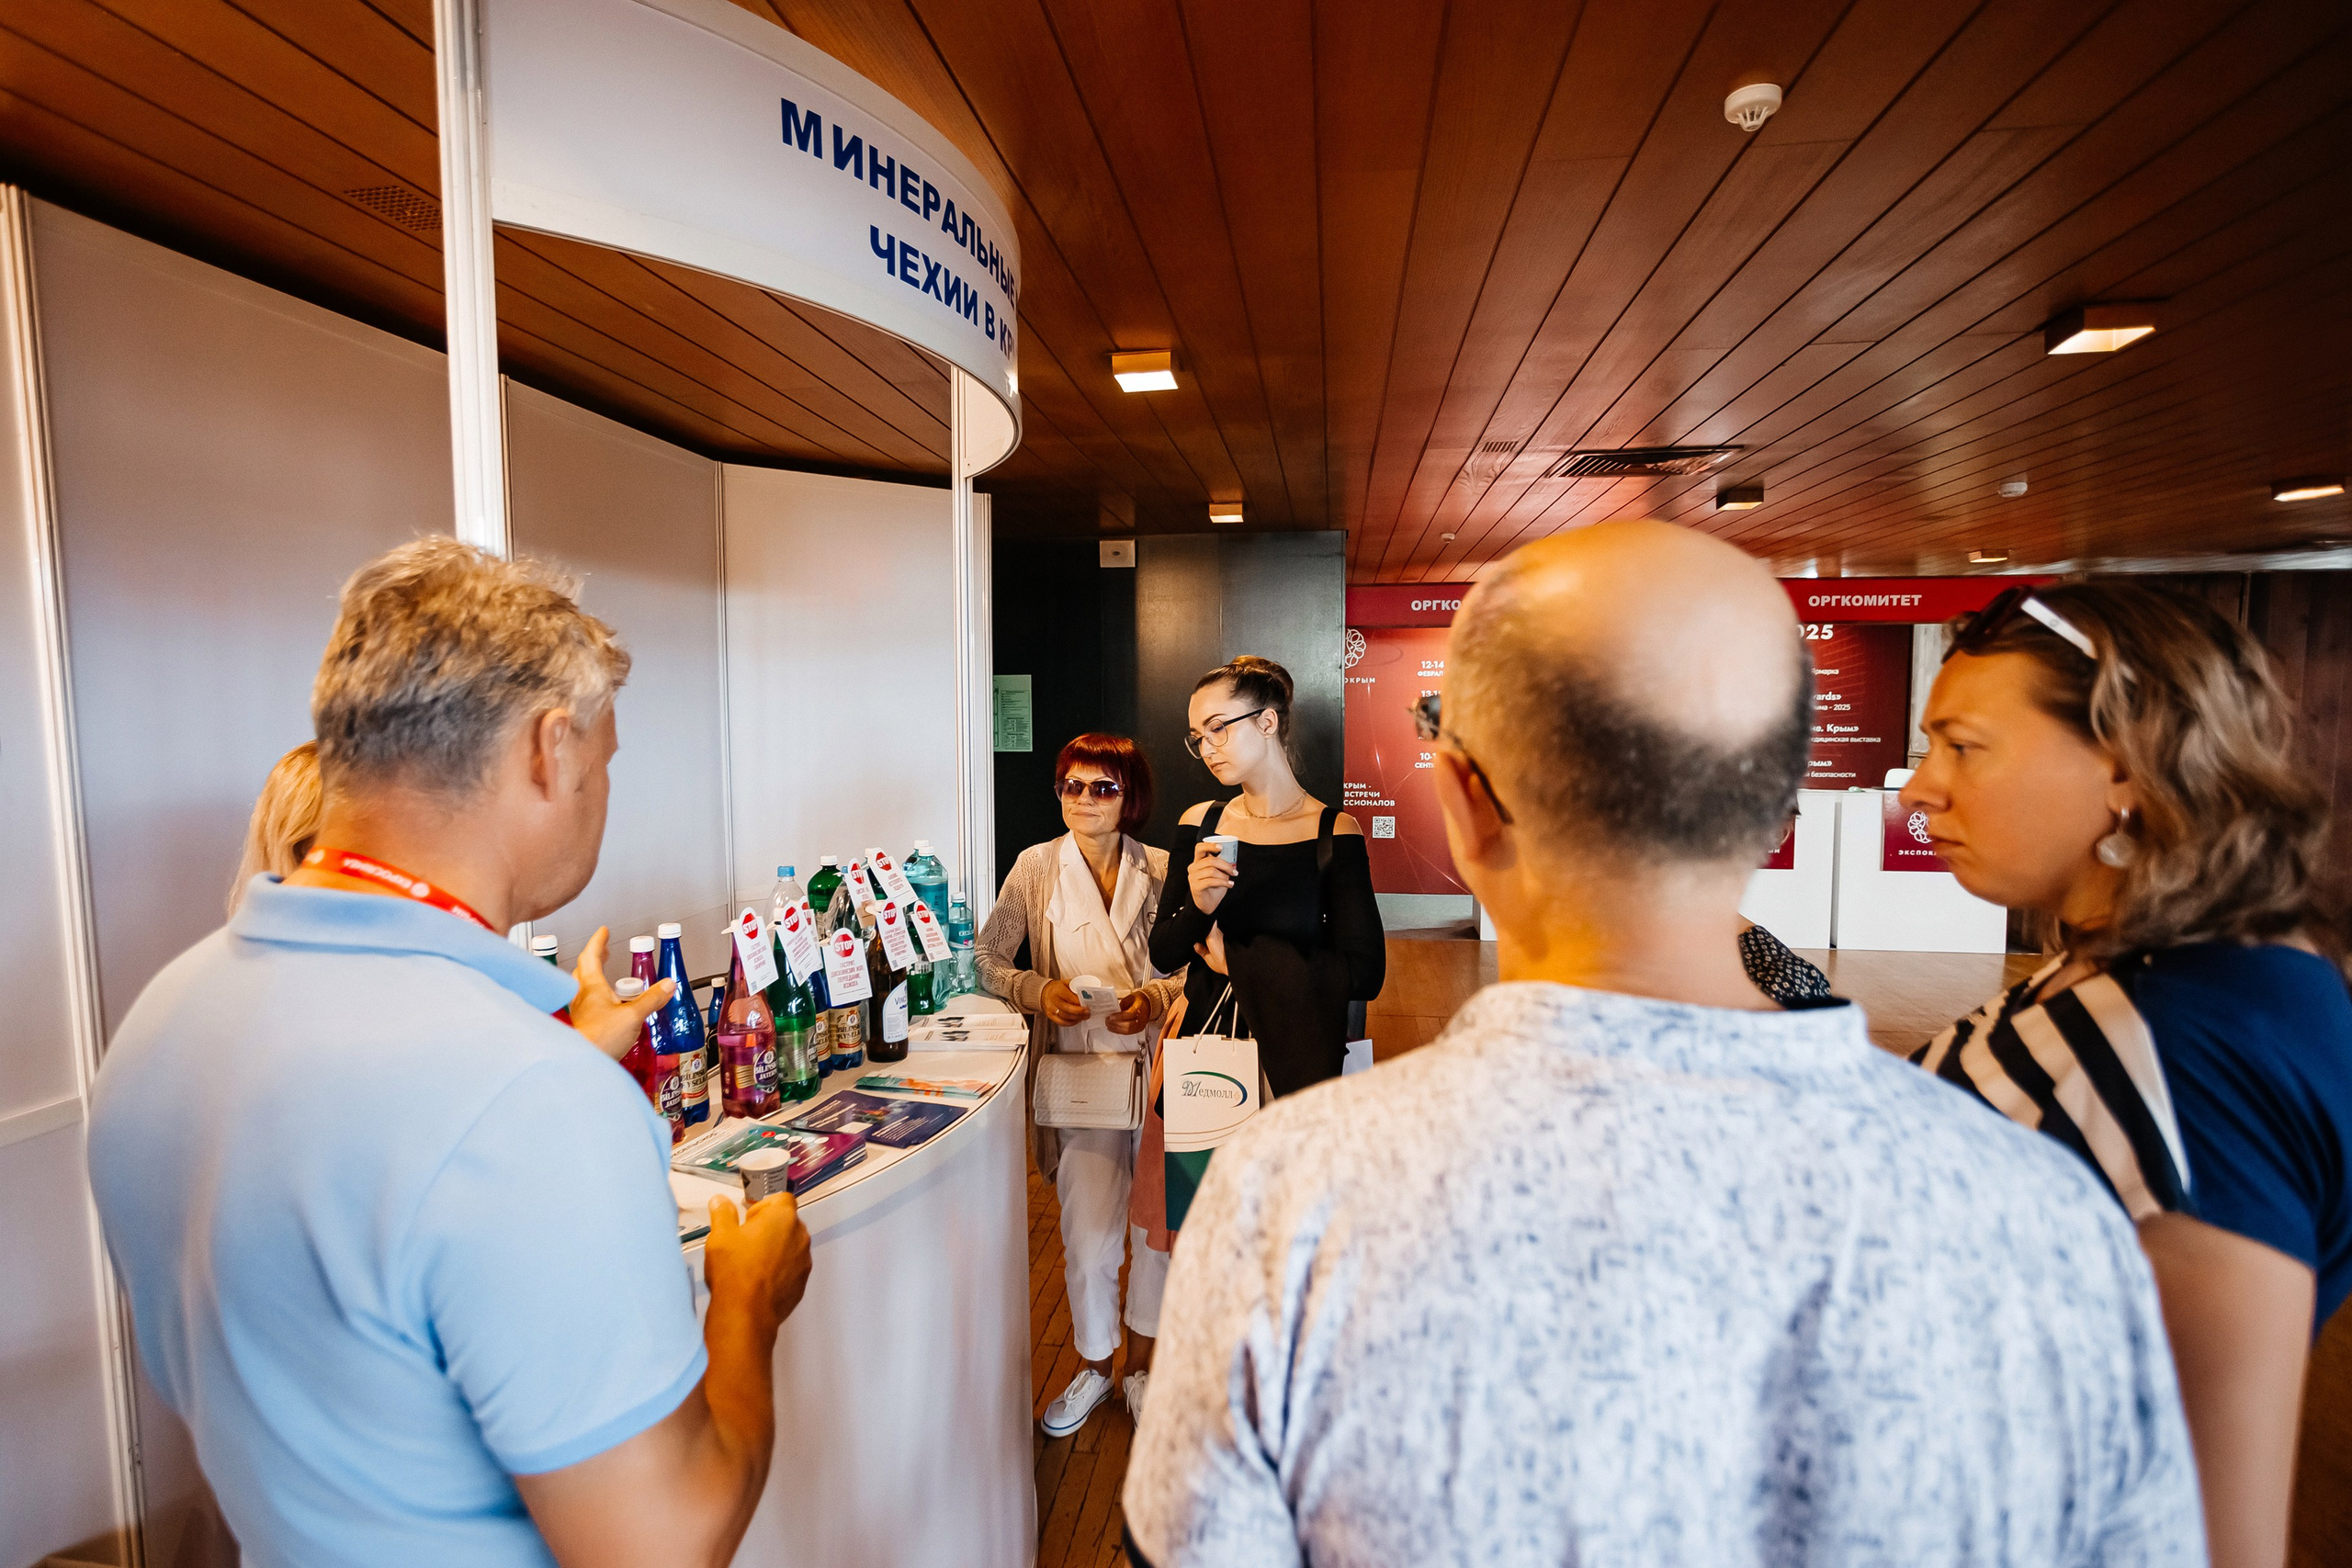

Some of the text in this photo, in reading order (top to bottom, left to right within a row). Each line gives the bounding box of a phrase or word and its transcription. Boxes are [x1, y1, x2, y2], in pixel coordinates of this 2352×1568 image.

[780, 96, 1015, 311] МИНЕРАЛЬНЫЕ
[869, 224, 1015, 361] ЧЕХИИ В КР
[1410, 599, 1462, 612] ОРГКО
[1807, 593, 1923, 607] ОРГКОМИТЕТ
[1420, 660, 1445, 669] 12-14
[1420, 690, 1442, 698] 13-1
[1826, 724, 1860, 734] Крым»
[1419, 752, 1437, 761] 10-1
[834, 940, 854, 953] STOP
[1181, 1079, 1233, 1100] Медмолл
